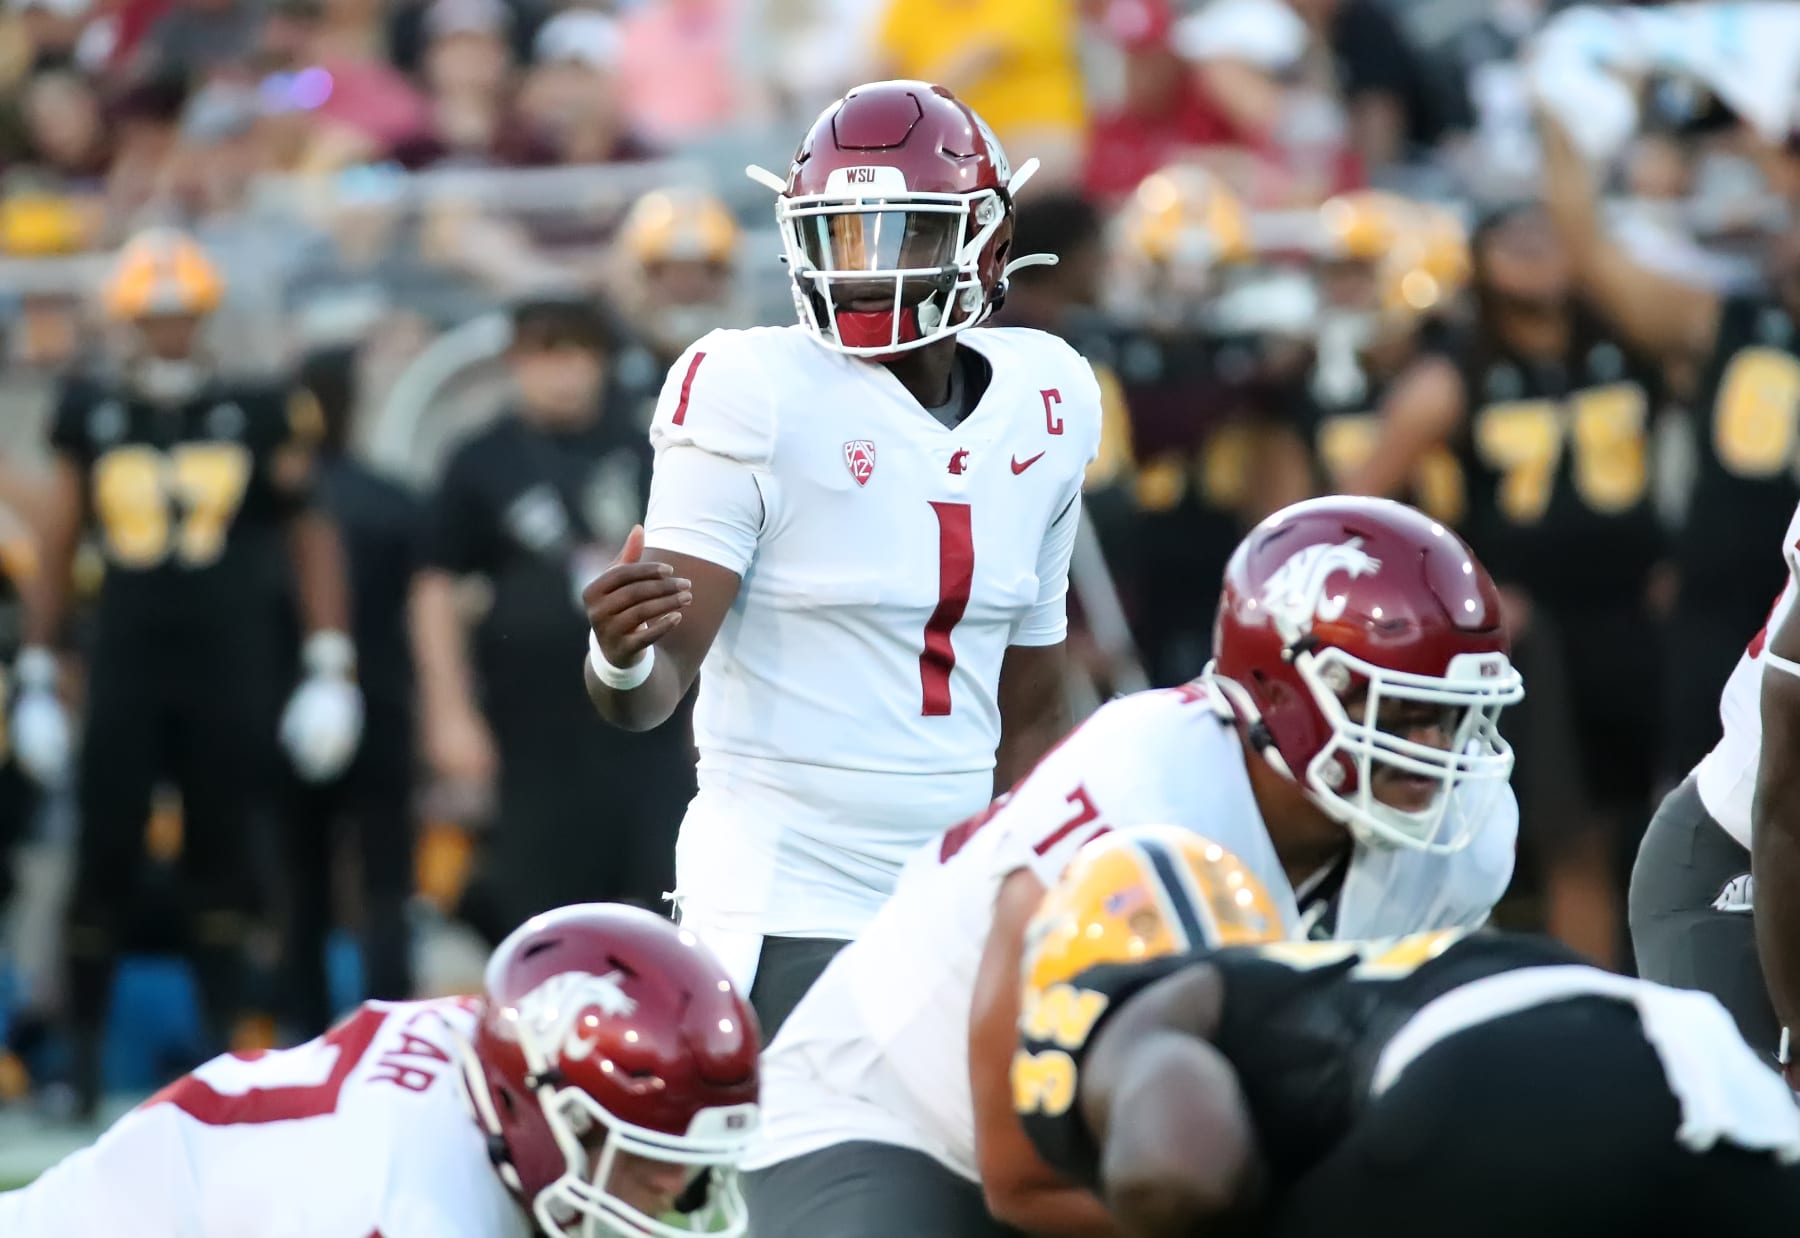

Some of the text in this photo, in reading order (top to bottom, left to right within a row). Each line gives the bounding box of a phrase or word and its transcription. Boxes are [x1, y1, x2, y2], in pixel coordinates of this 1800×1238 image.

[846, 168, 876, 184] WSU
[672, 351, 707, 427] 1
[1039, 388, 1064, 435] C
[844, 440, 875, 467] PAC
[853, 458, 870, 477] 12
[919, 500, 975, 716] 1
[1033, 780, 1114, 857] 7
